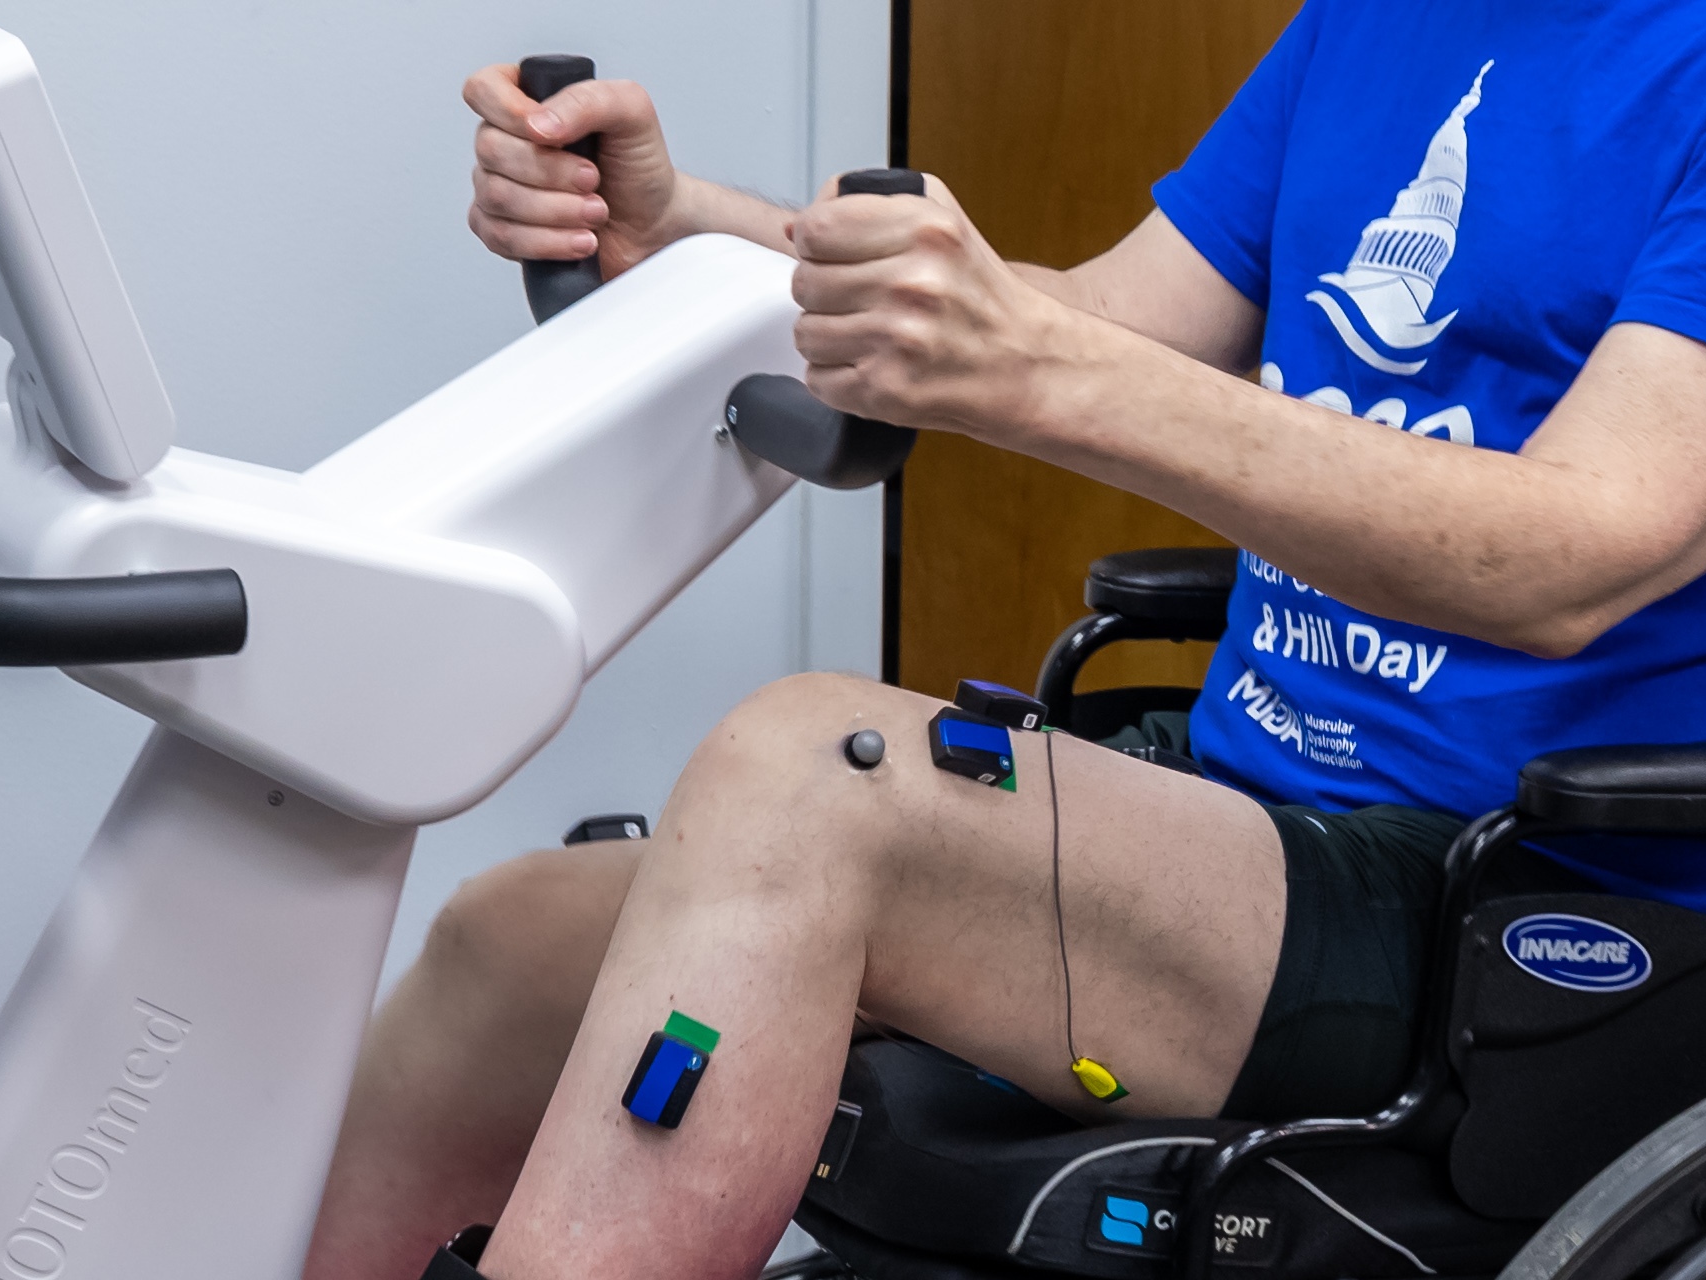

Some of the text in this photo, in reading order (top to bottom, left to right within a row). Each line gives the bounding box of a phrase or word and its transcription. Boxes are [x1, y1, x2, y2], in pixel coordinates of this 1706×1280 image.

[1253, 602, 1448, 693] & Hill Day
[1304, 712, 1355, 735] Muscular
[1307, 730, 1357, 755] Dystrophy
[1309, 746, 1363, 770] Association
[1518, 937, 1631, 964] INVACARE
